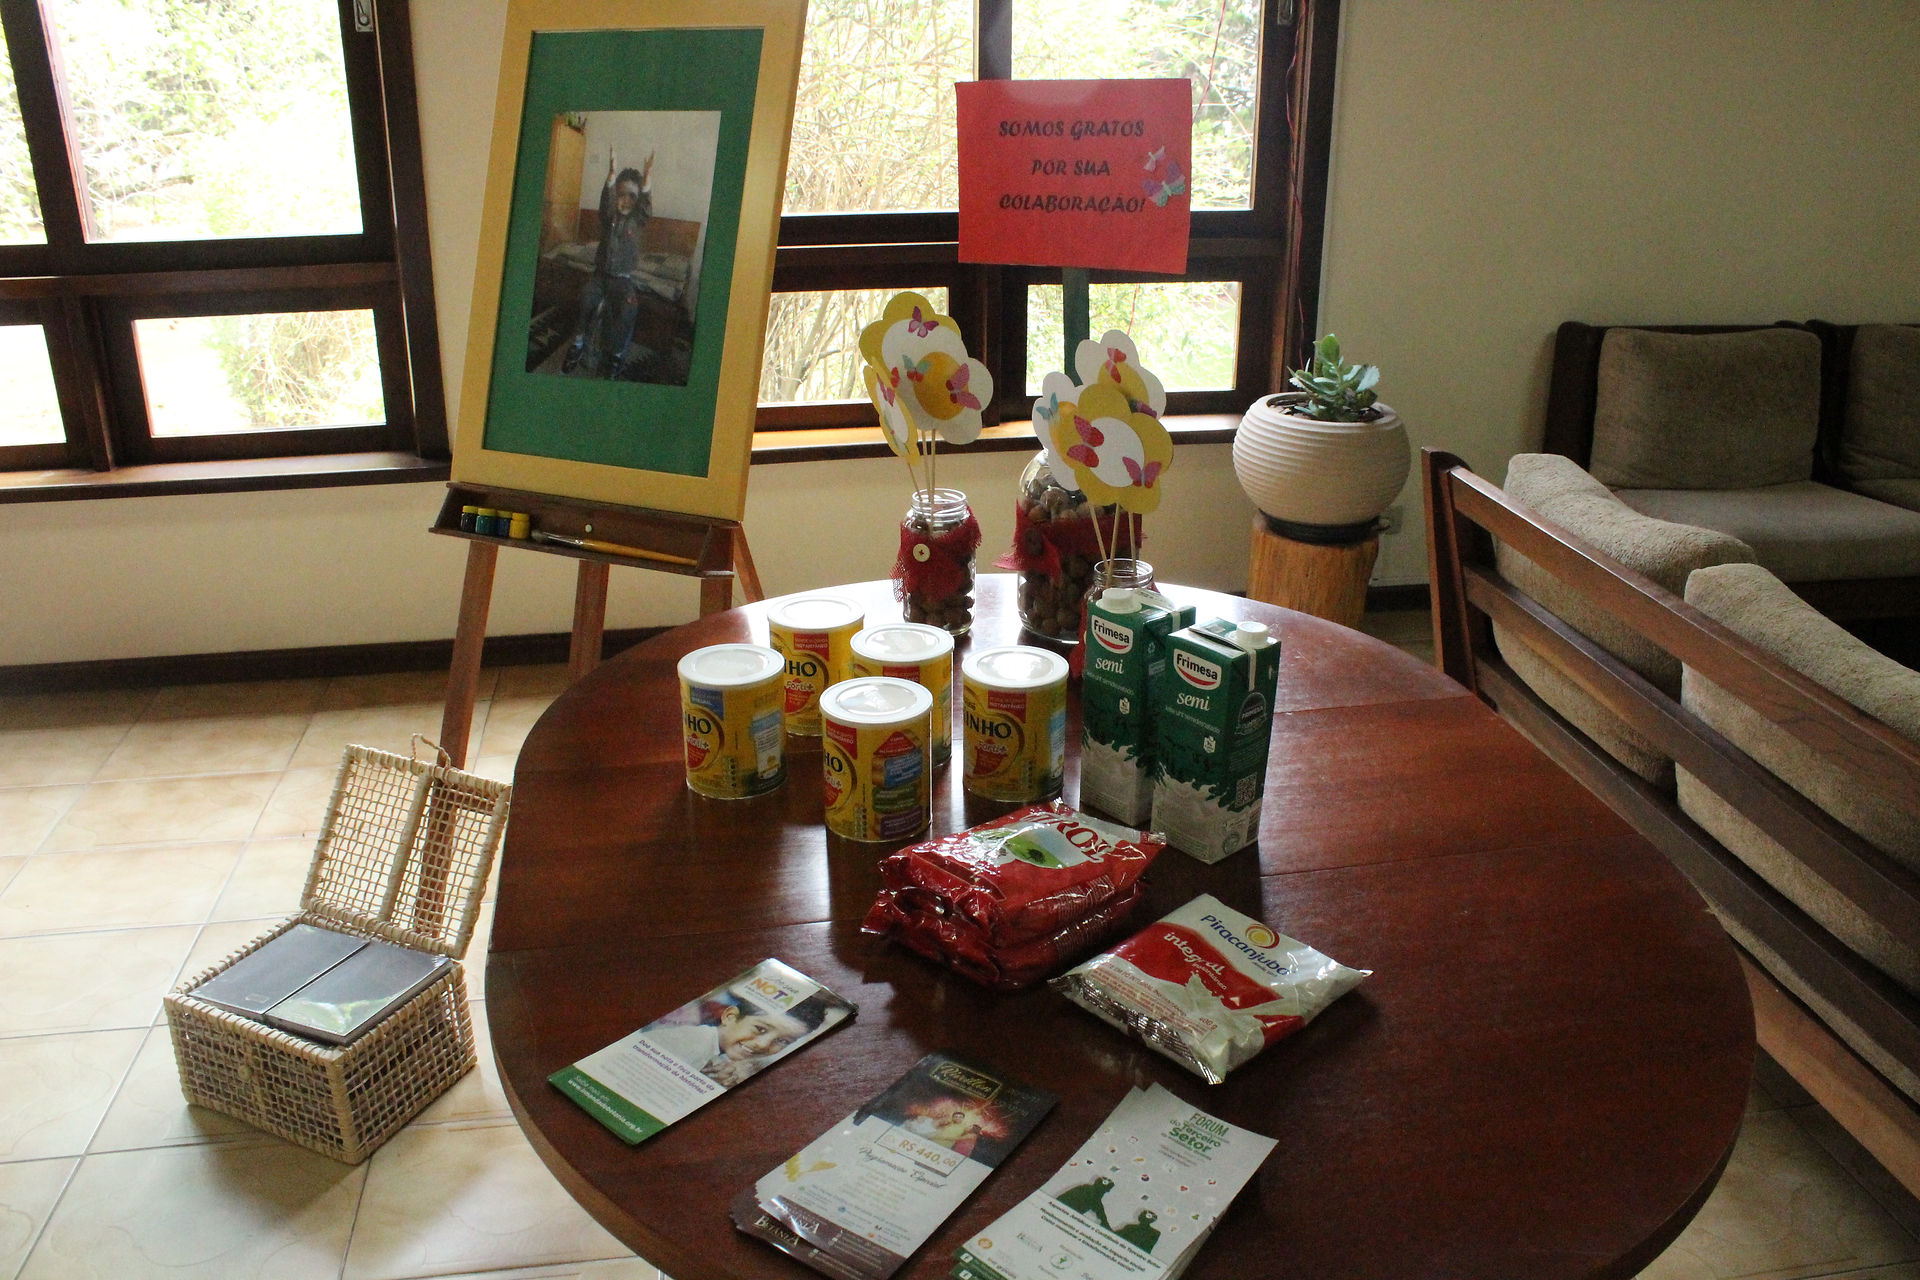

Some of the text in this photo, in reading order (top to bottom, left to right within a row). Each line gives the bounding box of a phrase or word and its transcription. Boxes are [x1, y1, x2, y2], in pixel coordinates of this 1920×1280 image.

[999, 120, 1145, 140] SOMOS GRATOS
[1031, 159, 1111, 176] POR SUA
[999, 193, 1145, 215] COLABORAÇÃO!
[1093, 619, 1130, 644] Frimesa
[1095, 657, 1124, 675] semi
[1176, 653, 1218, 680] Frimesa
[1176, 692, 1210, 712] semi
[750, 978, 794, 1006] NOTA
[1169, 1127, 1212, 1152] Setor
[1181, 1121, 1221, 1147] Terceiro
